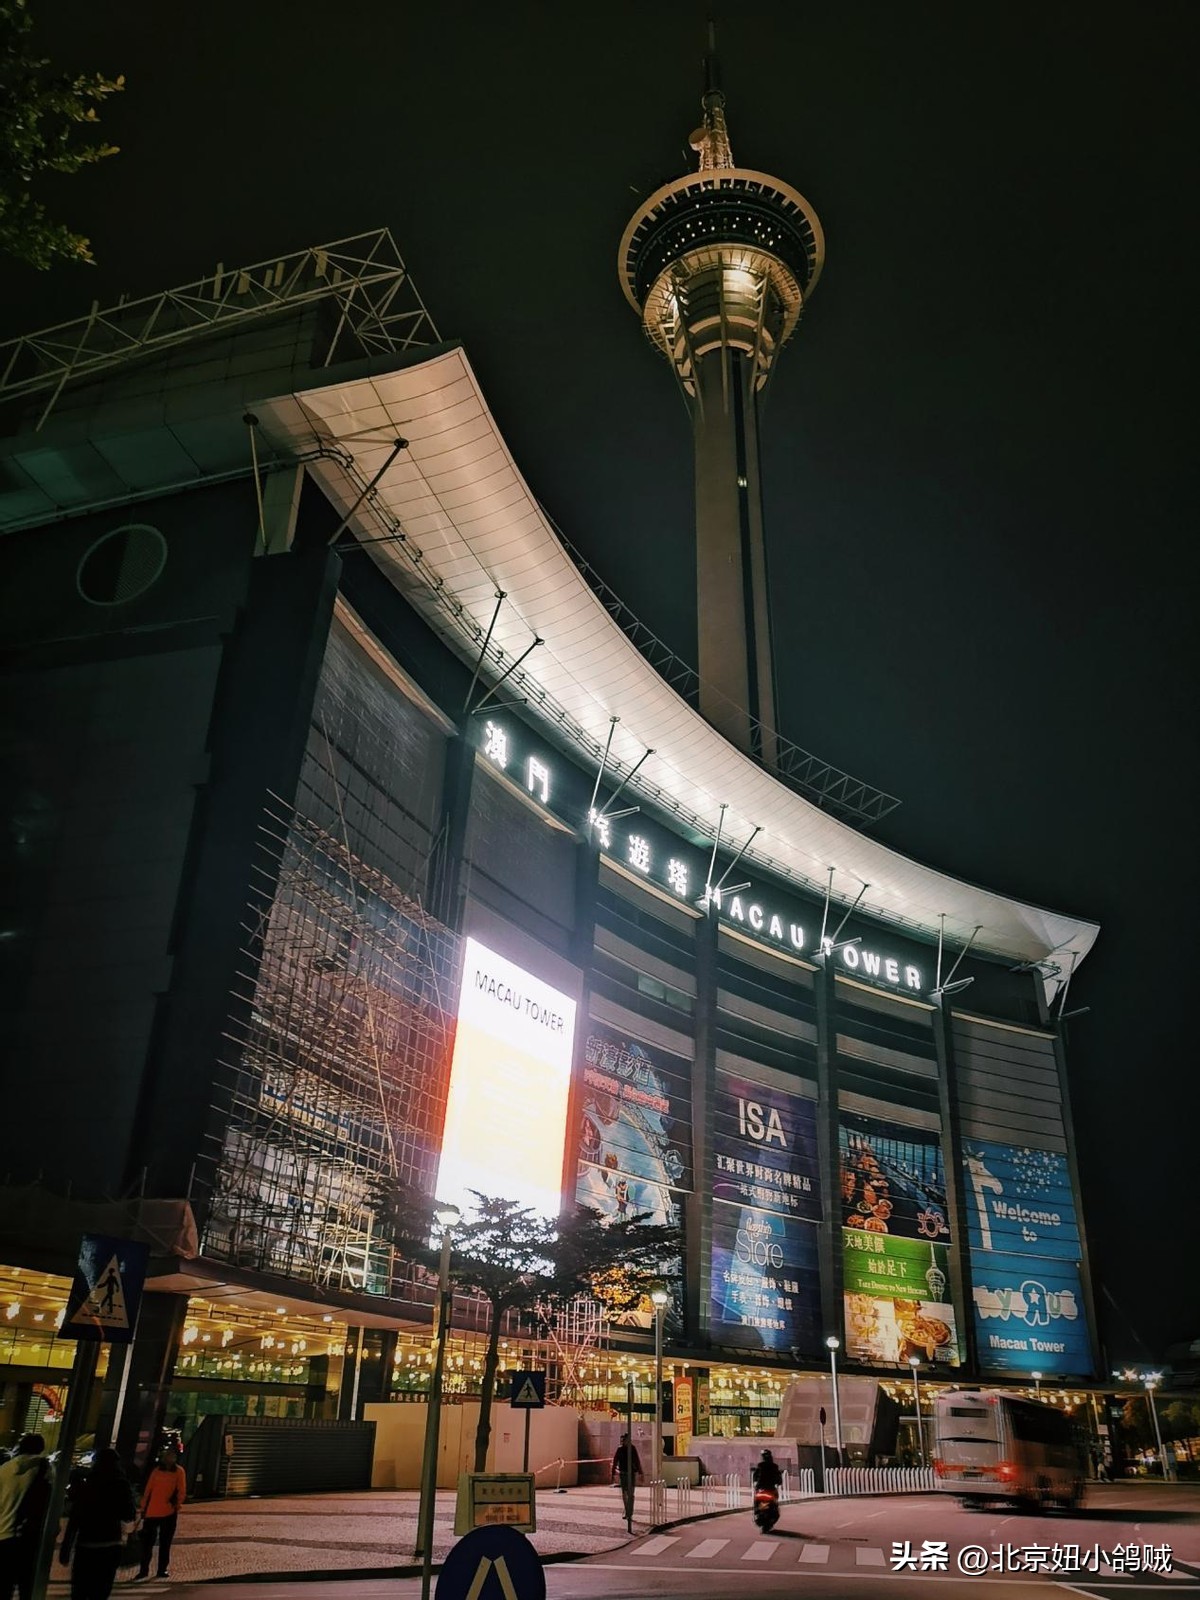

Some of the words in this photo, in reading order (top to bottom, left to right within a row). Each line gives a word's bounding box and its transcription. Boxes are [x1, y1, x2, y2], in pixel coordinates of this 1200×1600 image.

[705, 883, 804, 948] MACAU
[822, 936, 922, 990] TOWER
[474, 970, 521, 1010] MACAU
[524, 998, 565, 1035] TOWER
[738, 1098, 787, 1147] ISA
[992, 1199, 1062, 1227] Welcome
[736, 1229, 783, 1268] Store
[1021, 1226, 1038, 1242] to
[989, 1335, 1028, 1351] Macau
[1029, 1337, 1066, 1353] Tower
